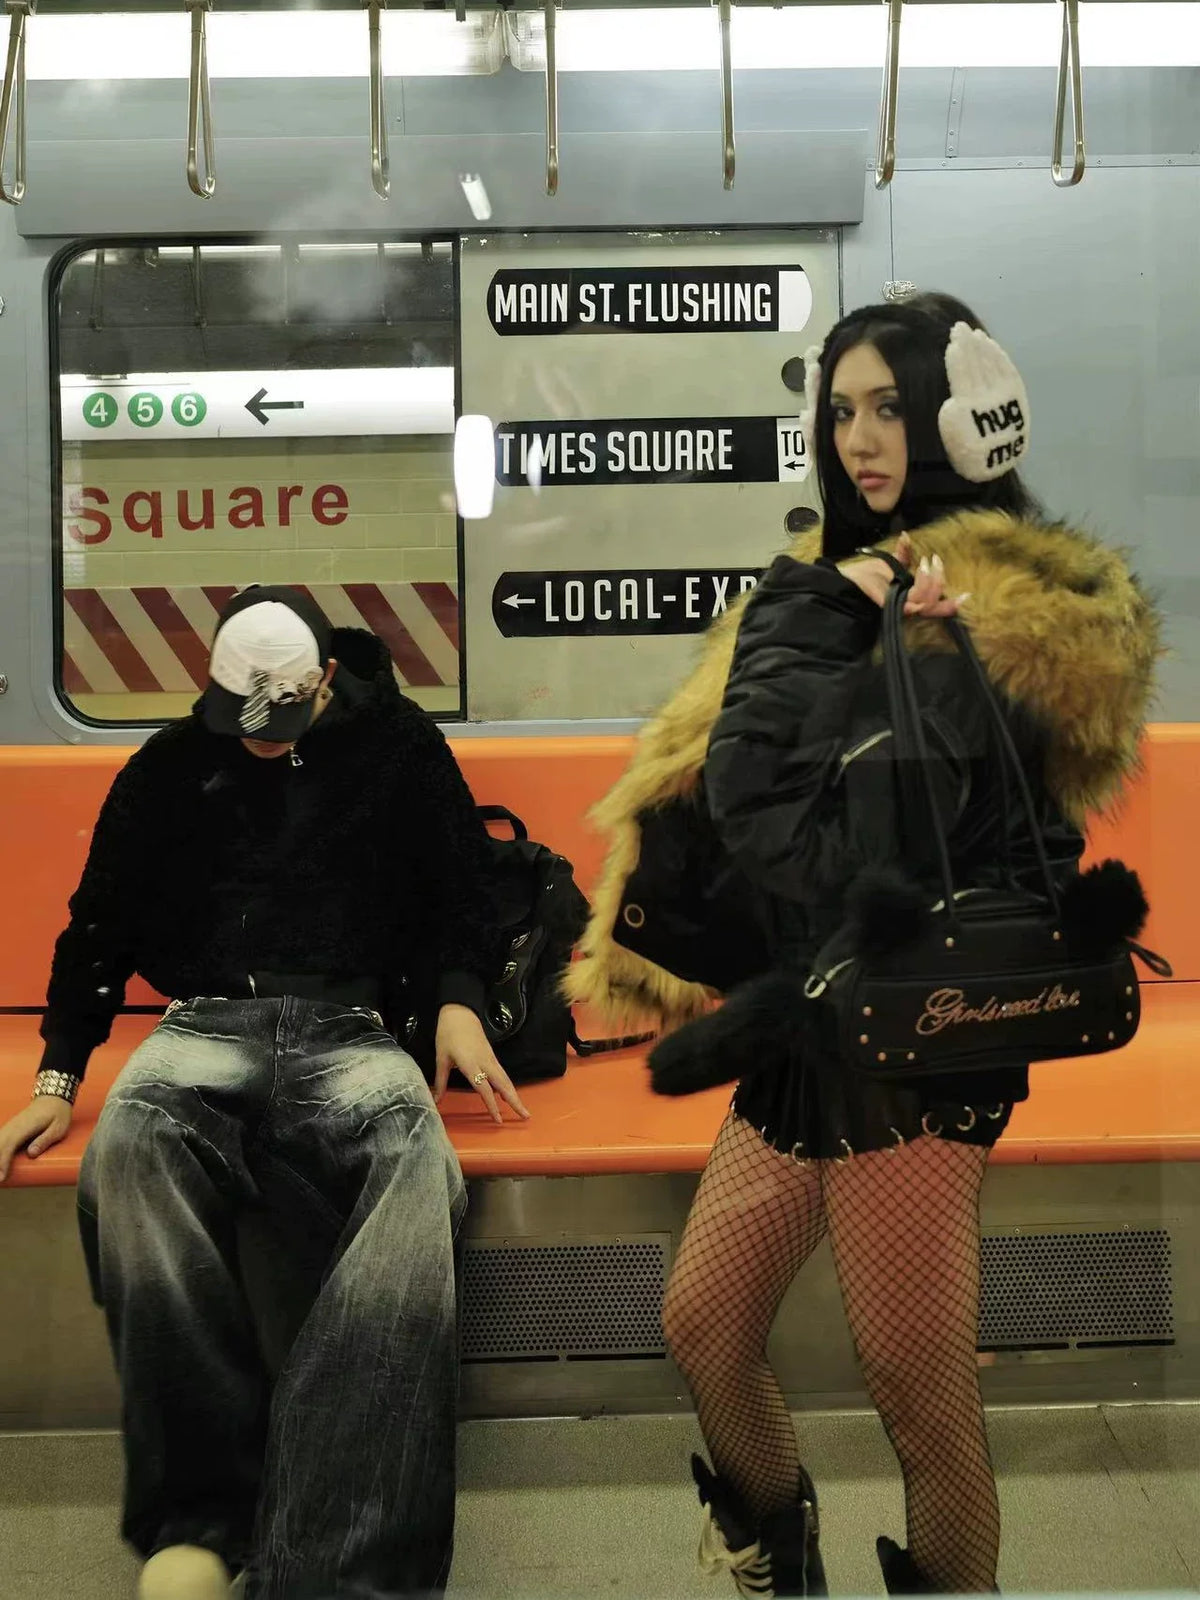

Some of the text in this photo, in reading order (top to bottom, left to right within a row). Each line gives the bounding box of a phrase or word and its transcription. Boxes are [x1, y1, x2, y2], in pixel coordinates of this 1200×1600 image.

[495, 282, 772, 323] MAIN ST. FLUSHING
[90, 396, 198, 422] 4 5 6
[971, 399, 1025, 437] hug
[499, 429, 733, 475] TIMES SQUARE
[781, 431, 805, 456] TO
[987, 435, 1024, 468] me
